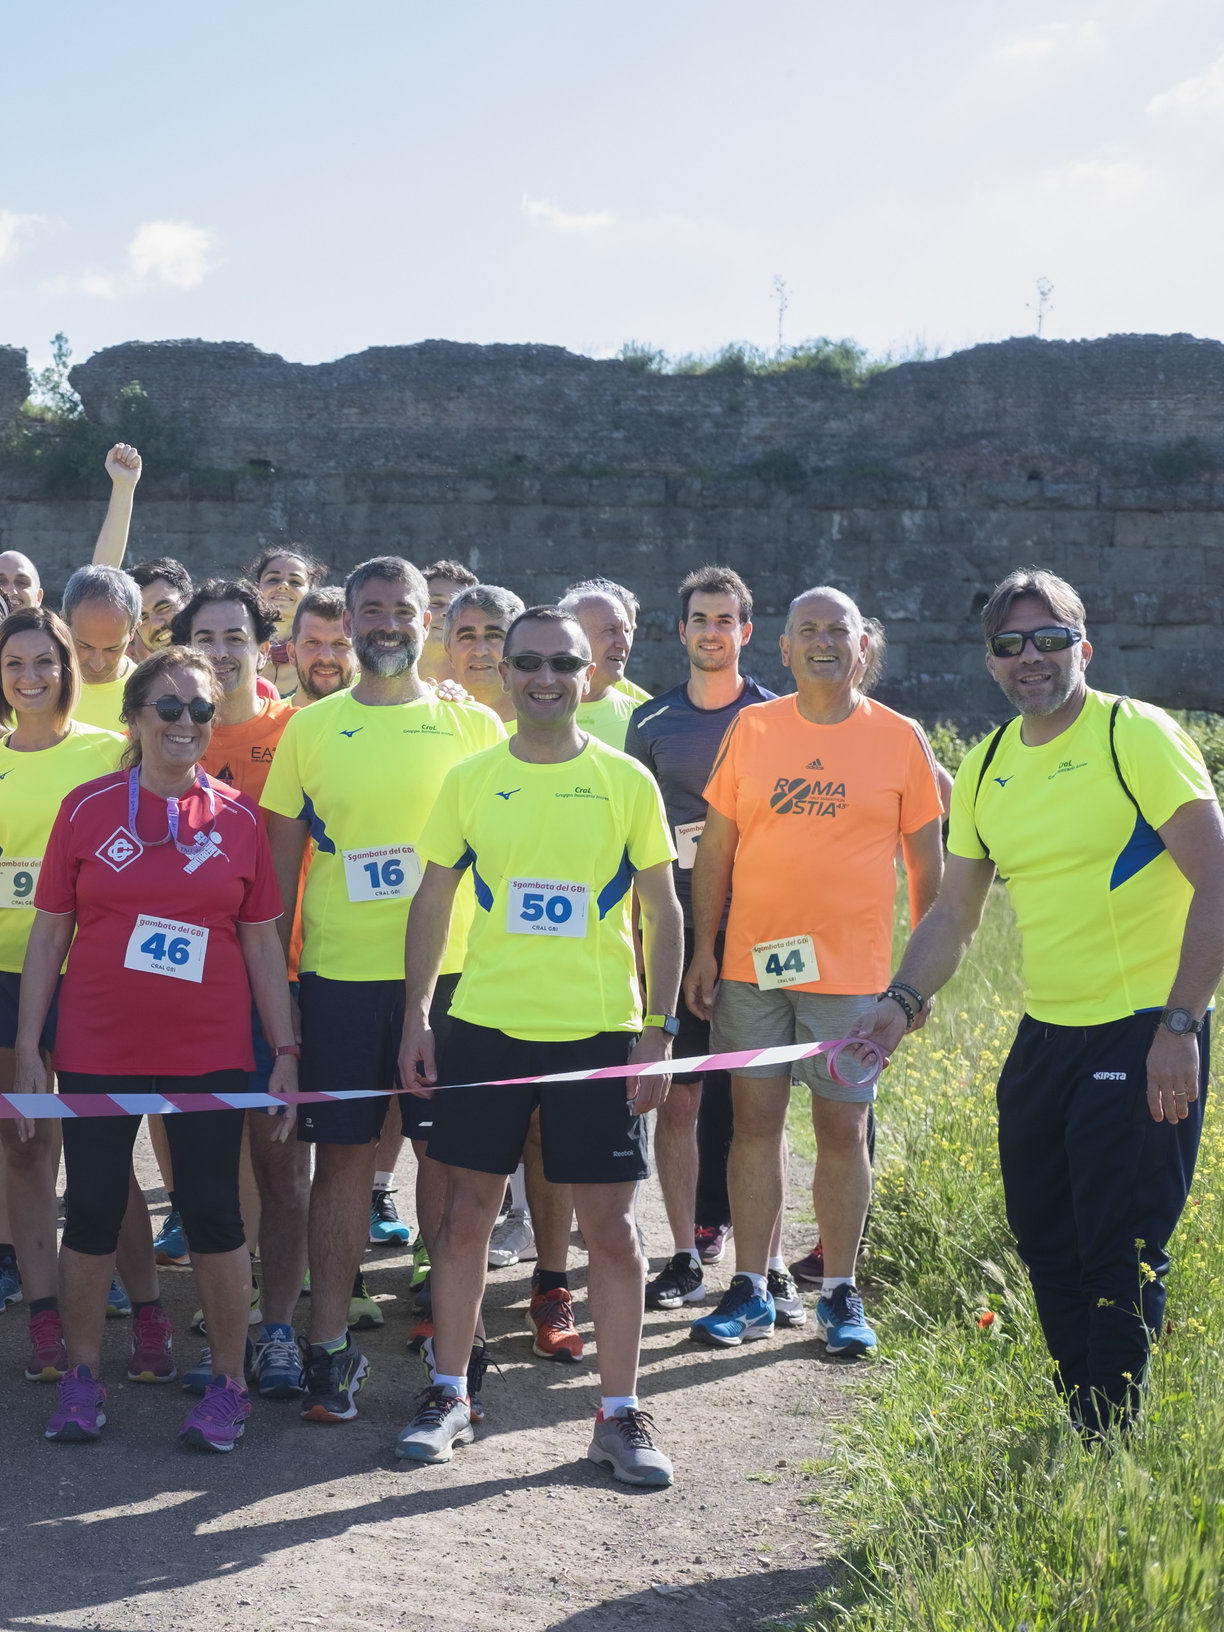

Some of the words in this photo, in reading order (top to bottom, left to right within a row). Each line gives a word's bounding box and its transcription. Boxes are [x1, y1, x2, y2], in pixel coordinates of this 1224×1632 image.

[347, 850, 388, 862] Sgambata
[389, 847, 401, 855] del
[13, 871, 33, 898] 9
[363, 859, 404, 889] 16
[513, 881, 555, 890] Sgambata
[556, 884, 569, 892] del
[570, 885, 585, 893] GBI
[519, 893, 573, 924] 50
[139, 919, 177, 931] gambata
[177, 926, 190, 934] del
[190, 928, 204, 938] GBI
[140, 932, 192, 966] 46
[150, 963, 165, 971] CRAL
[765, 949, 806, 977] 44
